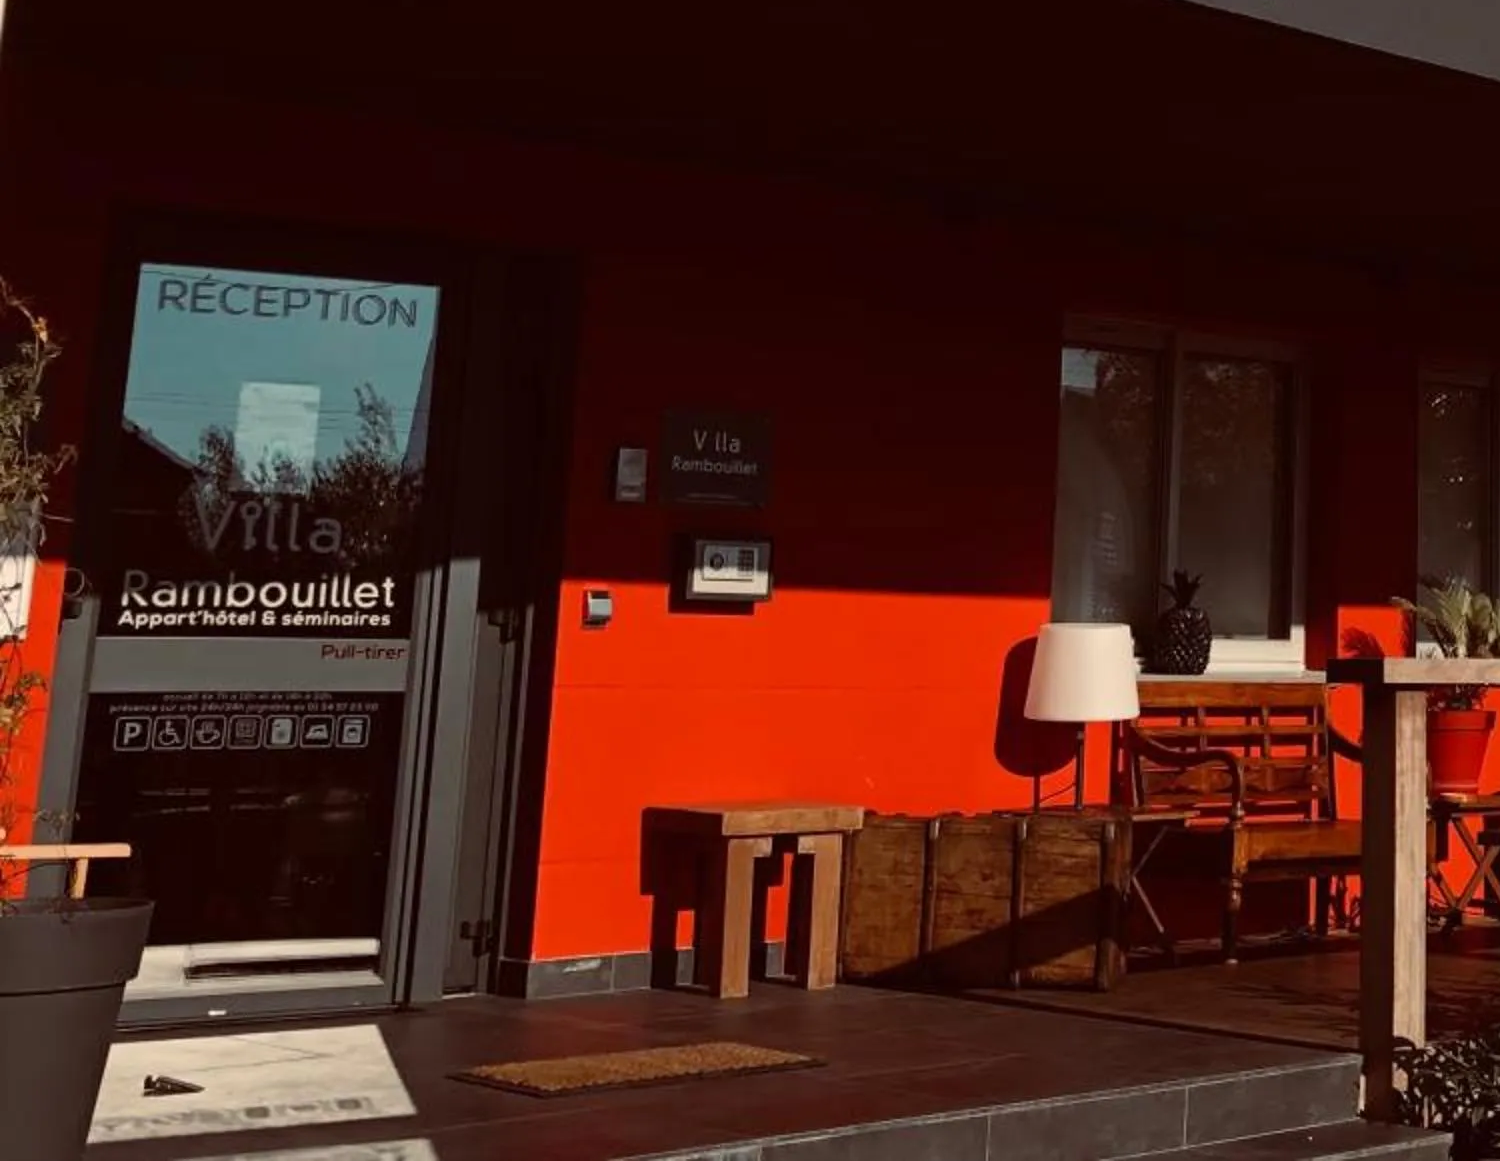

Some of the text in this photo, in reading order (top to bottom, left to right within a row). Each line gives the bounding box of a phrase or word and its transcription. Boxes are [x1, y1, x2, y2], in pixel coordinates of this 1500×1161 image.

[157, 273, 418, 328] RÉCEPTION
[693, 428, 742, 454] Vlla
[198, 499, 343, 555] Villa
[120, 569, 396, 608] Rambouillet
[261, 612, 277, 627] &
[281, 611, 392, 627] séminaires
[321, 644, 406, 661] Pull-tirer
